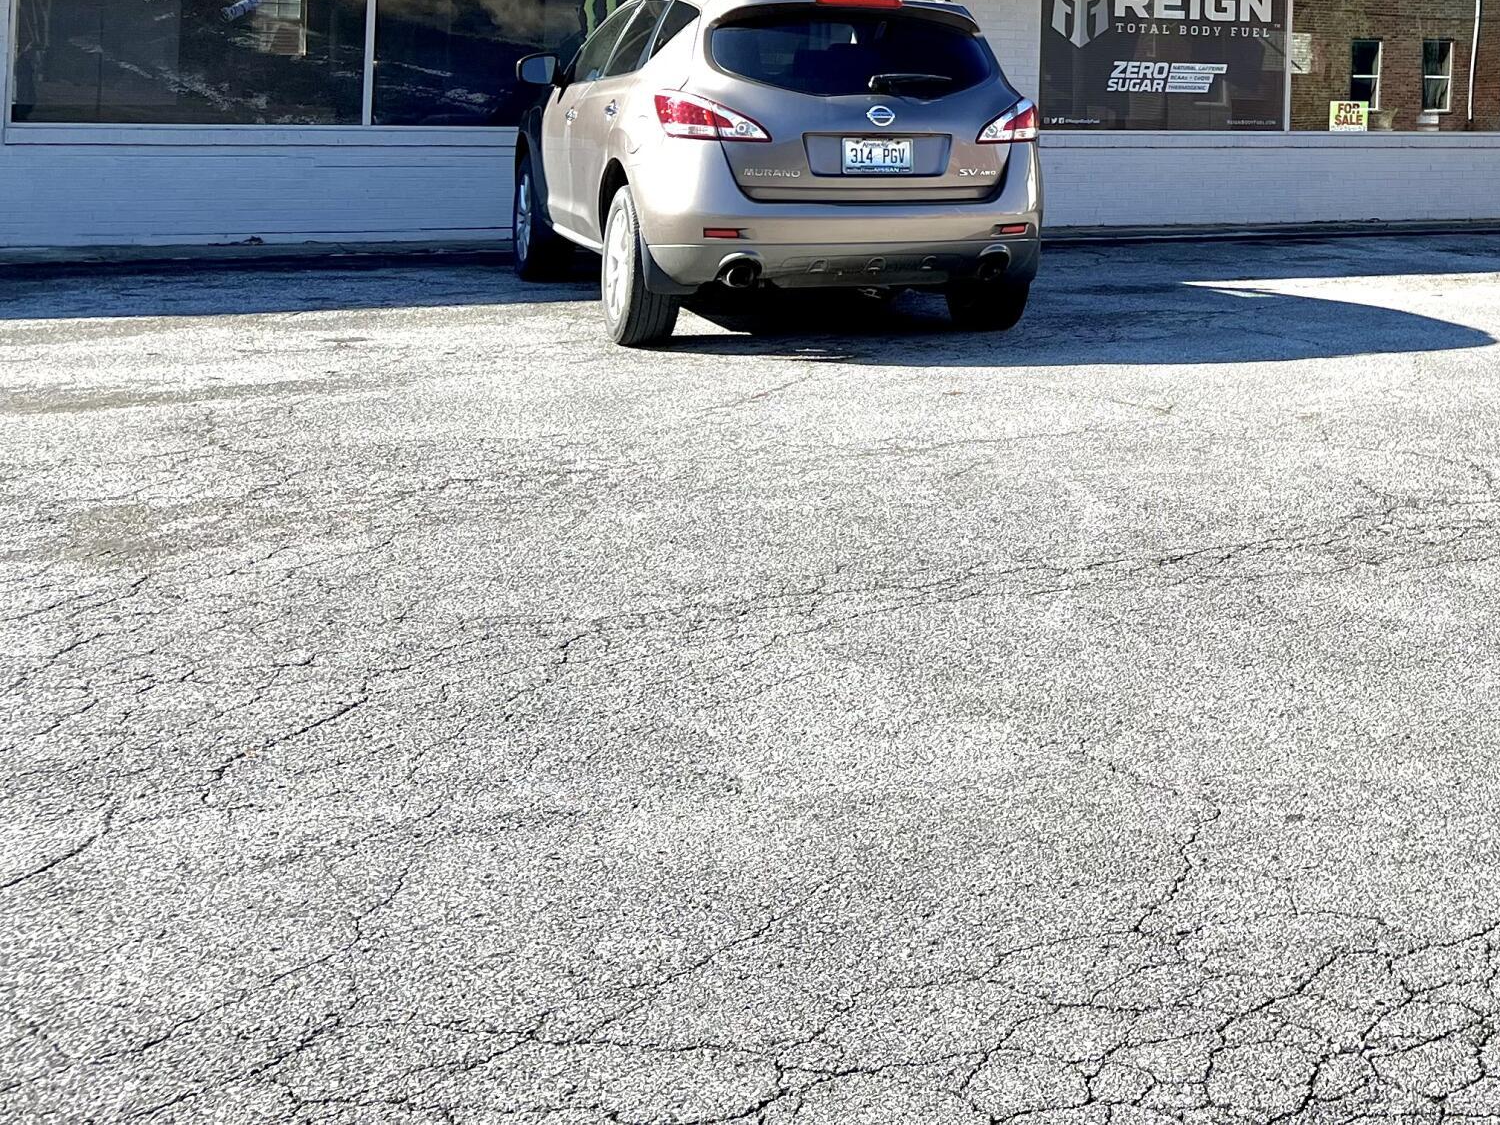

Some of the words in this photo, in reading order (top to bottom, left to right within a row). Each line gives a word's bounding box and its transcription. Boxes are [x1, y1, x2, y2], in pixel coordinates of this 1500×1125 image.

[1115, 23, 1170, 35] TOTAL
[1179, 25, 1222, 37] BODY
[1230, 27, 1270, 38] FUEL
[1110, 61, 1169, 79] ZERO
[1106, 78, 1164, 93] SUGAR
[1338, 103, 1360, 114] FOR
[1334, 114, 1364, 126] SALE
[850, 148, 873, 164] 314
[882, 148, 905, 164] PGV
[743, 168, 801, 178] MURANO
[959, 168, 978, 176] SV
